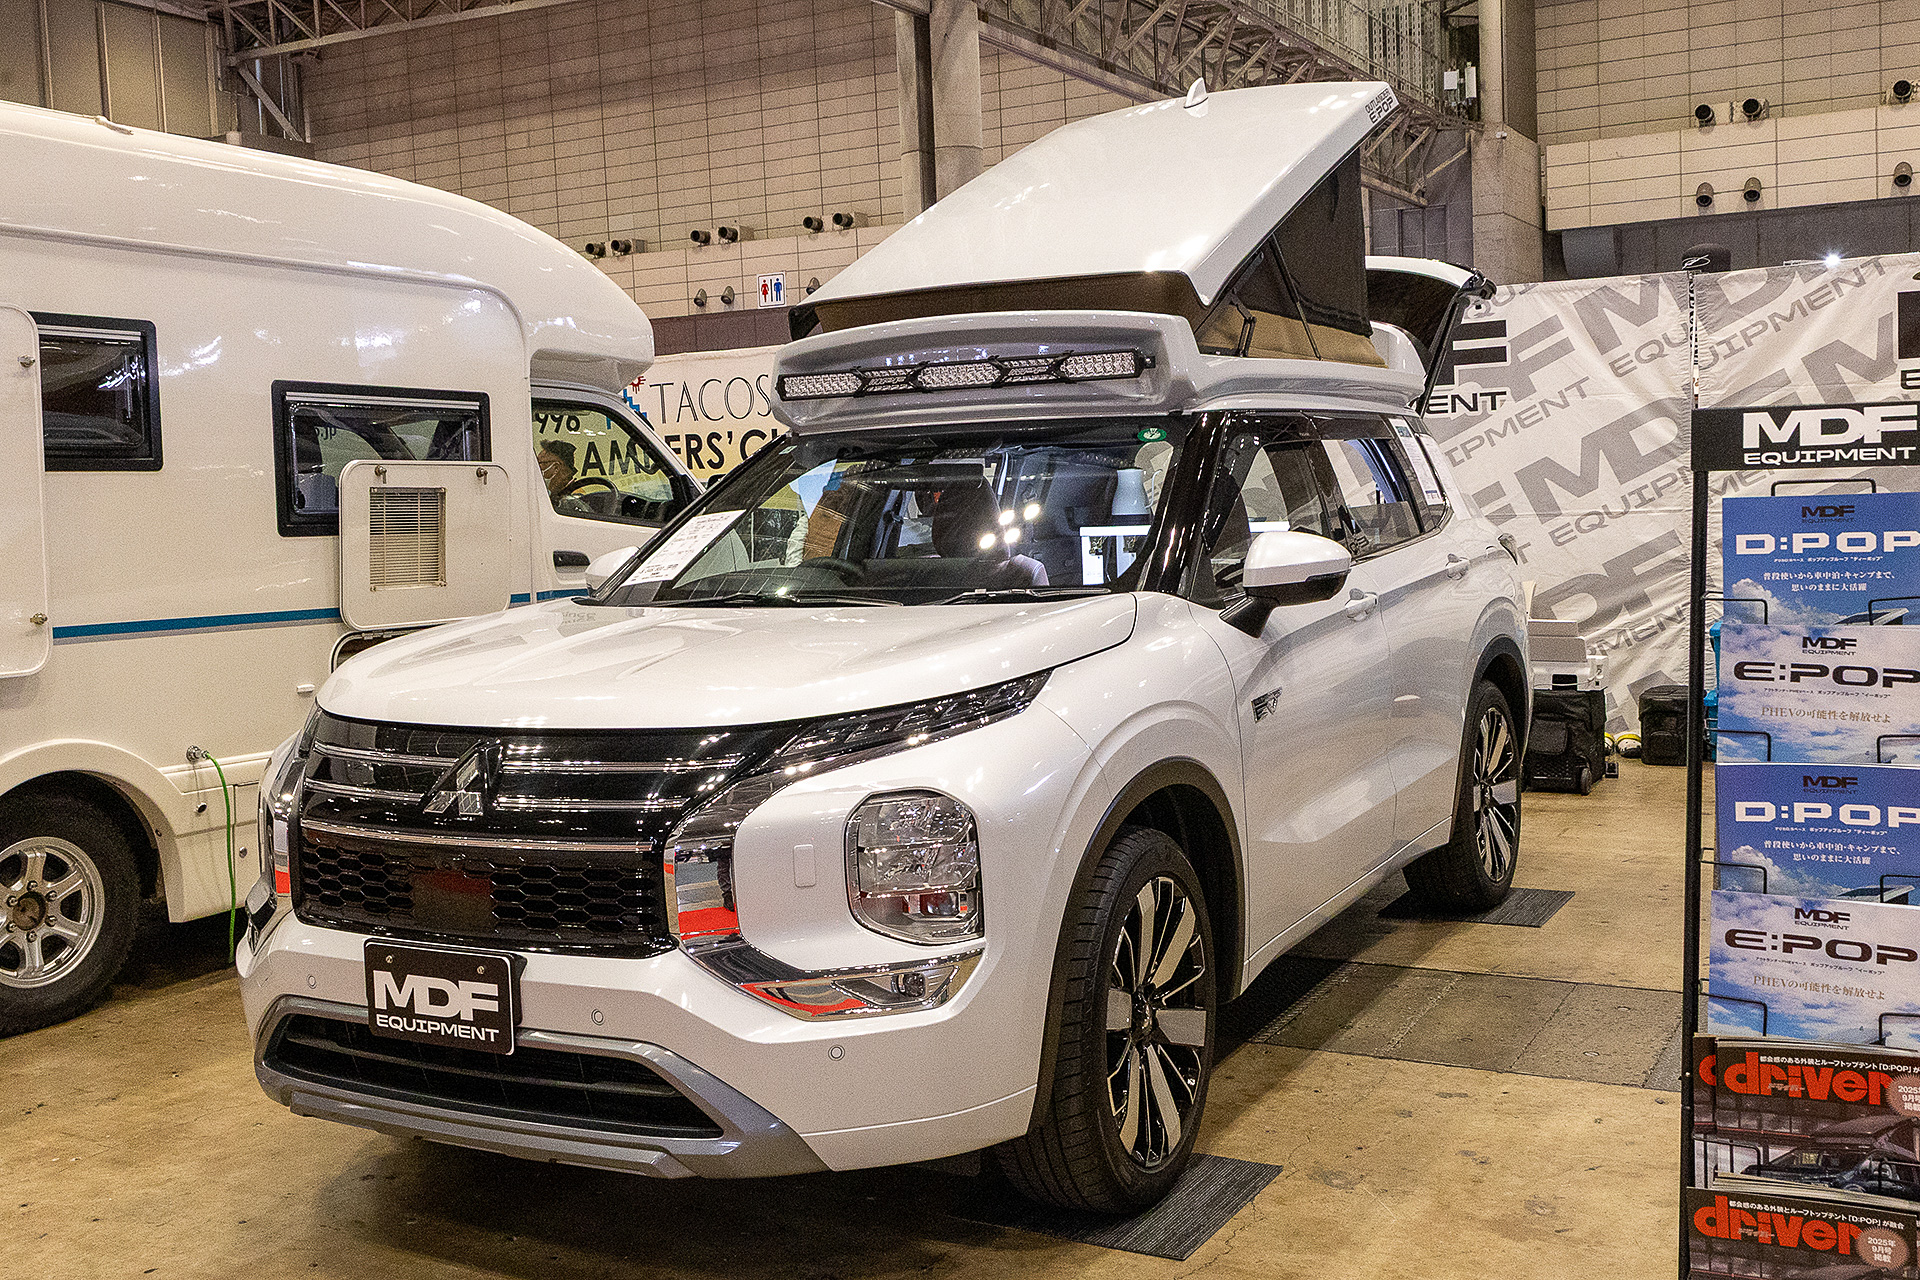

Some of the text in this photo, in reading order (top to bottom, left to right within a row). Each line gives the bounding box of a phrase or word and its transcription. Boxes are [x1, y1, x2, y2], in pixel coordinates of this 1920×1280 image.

[650, 373, 772, 425] TACOS
[1743, 404, 1918, 449] MDF
[1744, 446, 1917, 465] EQUIPMENT
[1802, 505, 1855, 518] MDF
[1736, 530, 1920, 555] D:POP
[1791, 582, 1868, 592] 思いのままに大活躍
[1802, 636, 1858, 650] MDF
[1734, 661, 1920, 689] E:POP
[1761, 706, 1891, 723] PHEVの可能性を解放せよ
[1802, 775, 1859, 789] MDF
[1735, 801, 1920, 828] D:POP
[1793, 853, 1872, 865] 思いのままに大活躍
[1794, 907, 1851, 924] MDF
[1794, 920, 1851, 930] EQUIPMENT
[1725, 928, 1918, 965] E:POP
[373, 969, 499, 1022] MDF
[1753, 975, 1885, 1000] PHEVの可能性を解放せよ
[376, 1013, 500, 1042] EQUIPMENT
[1723, 1051, 1894, 1105] driver
[1693, 1195, 1864, 1256] driver
[1867, 1236, 1897, 1248] 2025年
